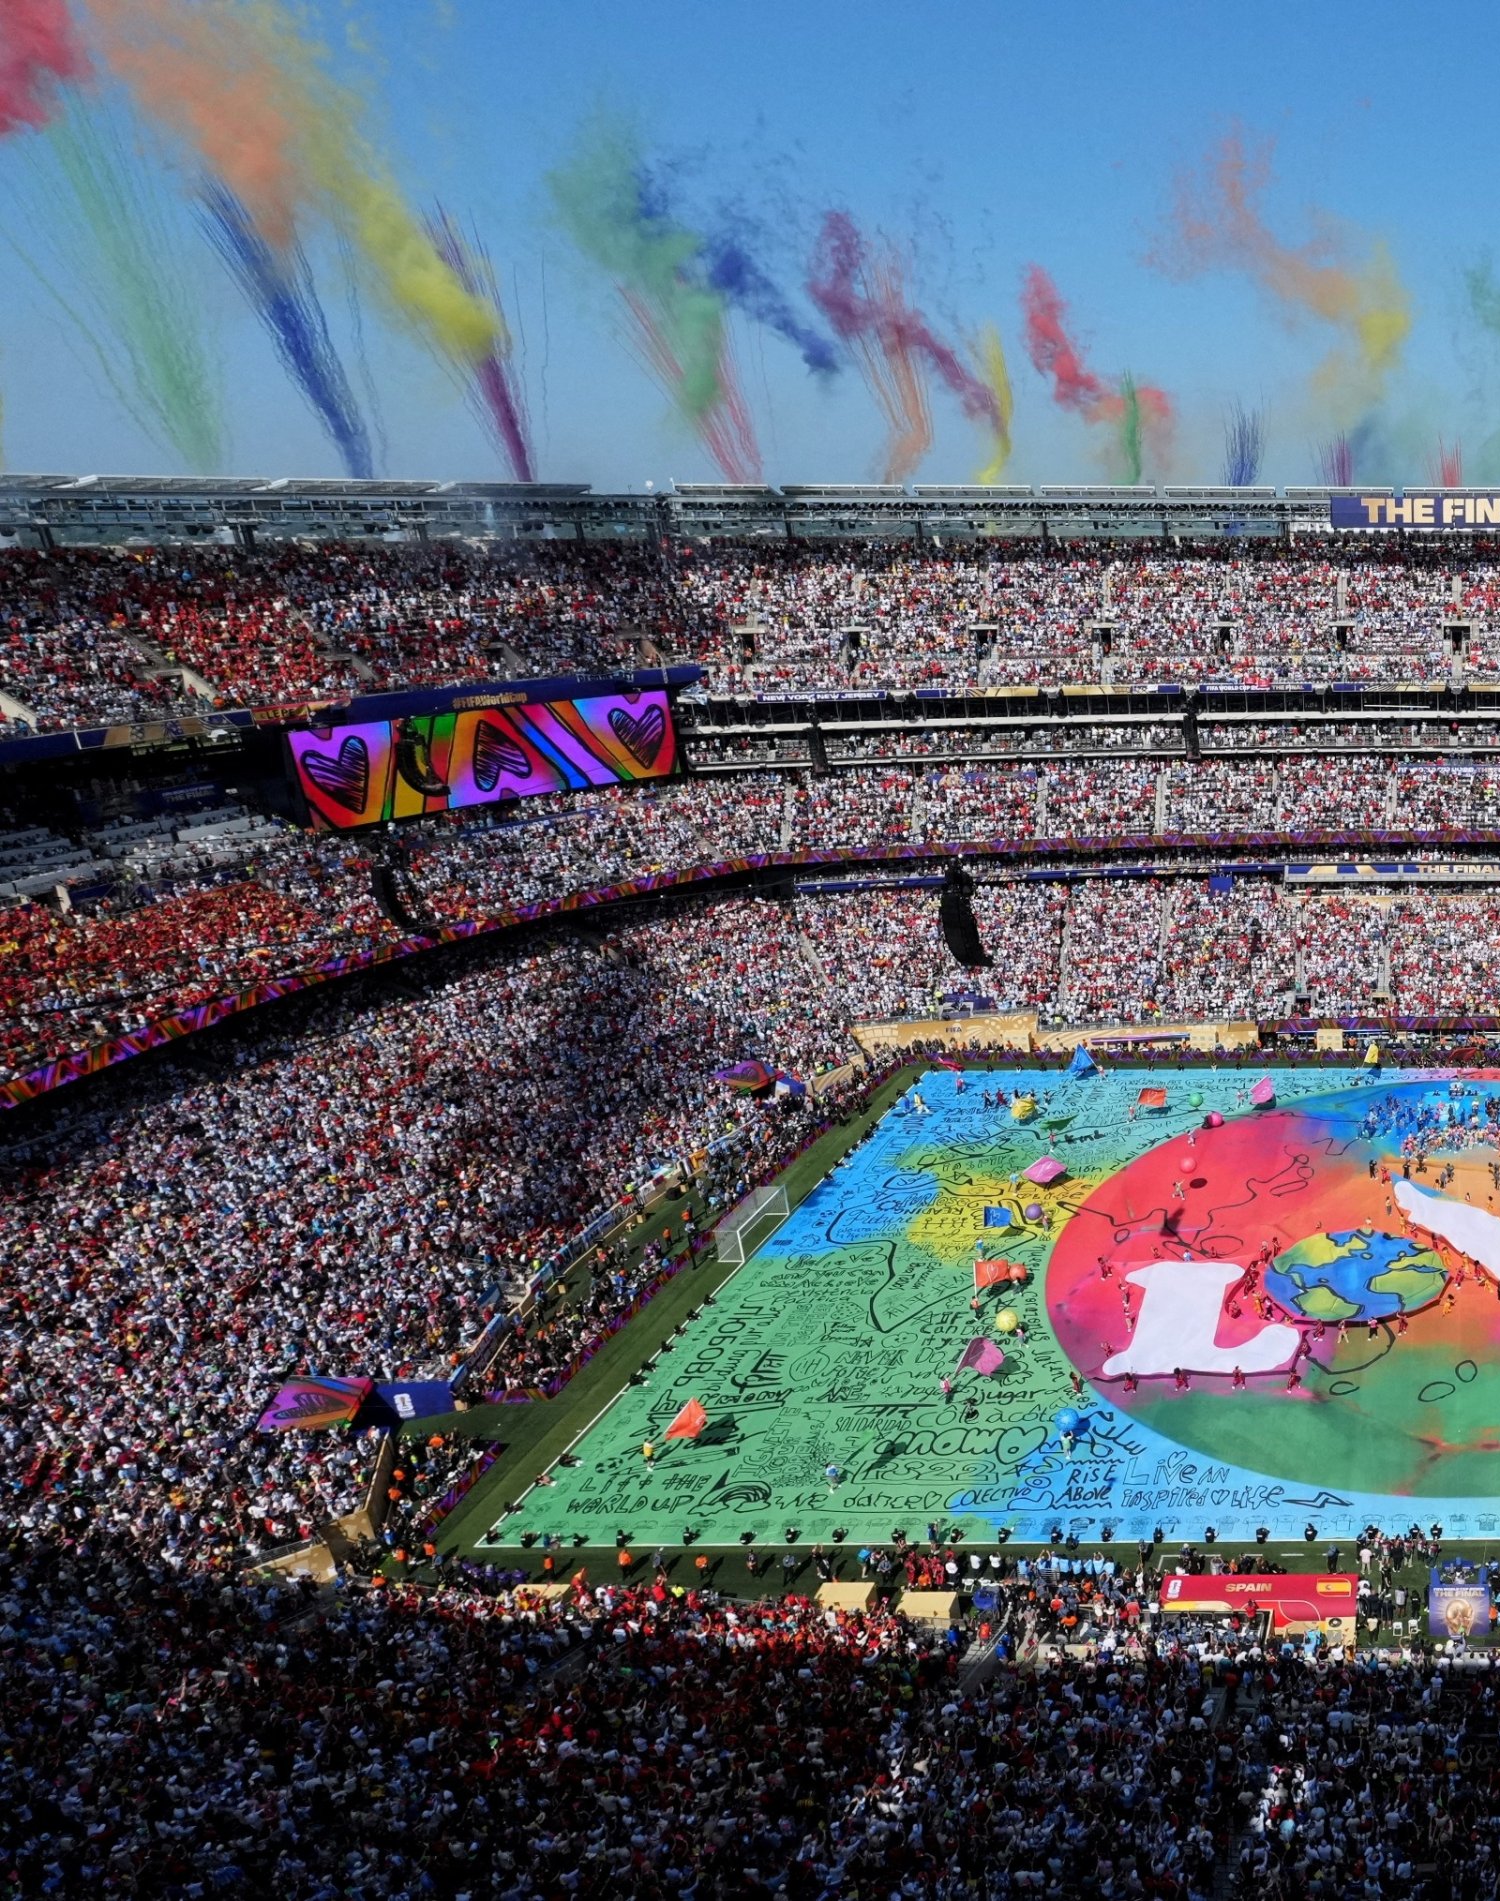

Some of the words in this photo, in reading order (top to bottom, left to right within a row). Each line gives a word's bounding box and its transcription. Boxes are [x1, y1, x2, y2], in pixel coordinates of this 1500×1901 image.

[1361, 498, 1435, 524] THE
[453, 692, 527, 709] #FIFAWorldCup
[763, 693, 785, 702] NEW
[787, 692, 815, 701] YORK
[816, 692, 840, 700] NEW
[841, 691, 880, 699] JERSEY
[1416, 864, 1455, 874] THE
[669, 1303, 764, 1386] ЛЮБОВЬ
[913, 1347, 950, 1363] DO
[976, 1389, 1045, 1405] jugar
[830, 1415, 915, 1432] SOLIDARIDAD
[562, 1497, 649, 1514] WORLD
[1225, 1582, 1272, 1593] SPAIN
